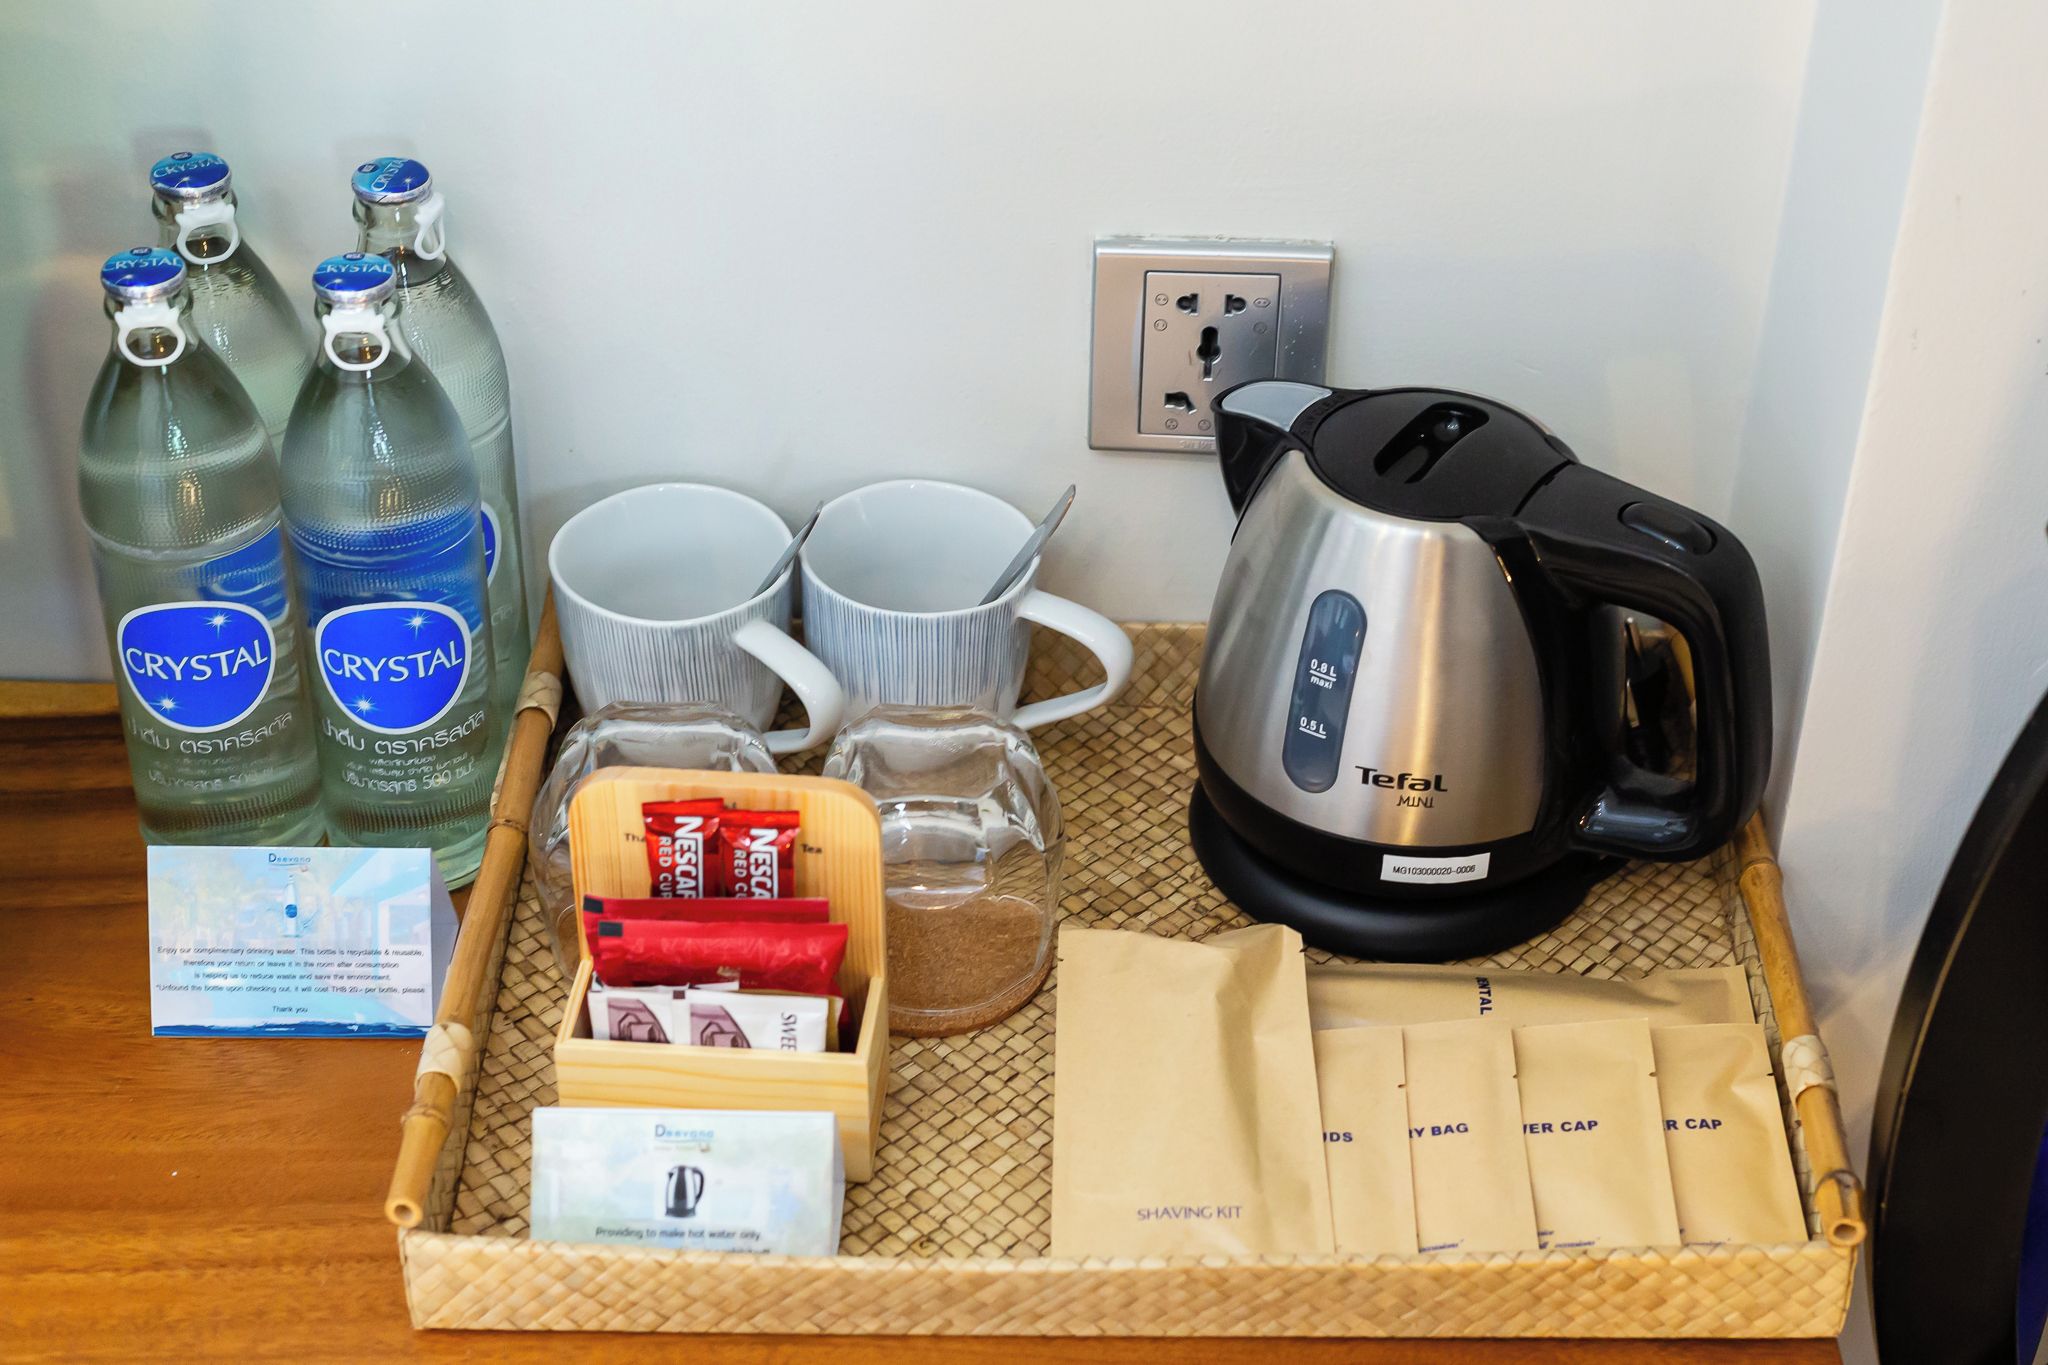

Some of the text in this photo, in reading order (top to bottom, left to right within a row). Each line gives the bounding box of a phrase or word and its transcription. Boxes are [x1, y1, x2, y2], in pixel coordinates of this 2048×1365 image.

[102, 256, 183, 272] CRYSTAL
[315, 263, 392, 274] CRYSTAL
[126, 638, 268, 682] CRYSTAL
[324, 640, 463, 683] CRYSTAL
[1310, 675, 1333, 690] maxi
[1319, 723, 1327, 735] L
[422, 769, 452, 791] 500
[1355, 765, 1448, 792] Tefal
[1396, 794, 1435, 808] MINI
[659, 835, 672, 868] RED
[802, 843, 822, 854] Tea
[734, 849, 747, 878] RED
[272, 1005, 293, 1013] Thank
[1431, 1122, 1469, 1136] BAG
[1560, 1120, 1599, 1132] CAP
[1685, 1118, 1723, 1130] CAP
[1136, 1205, 1243, 1221] SHAVING KIT
[595, 1226, 644, 1240] Providing
[646, 1228, 657, 1237] to
[688, 1229, 704, 1238] hot
[708, 1230, 736, 1238] water
